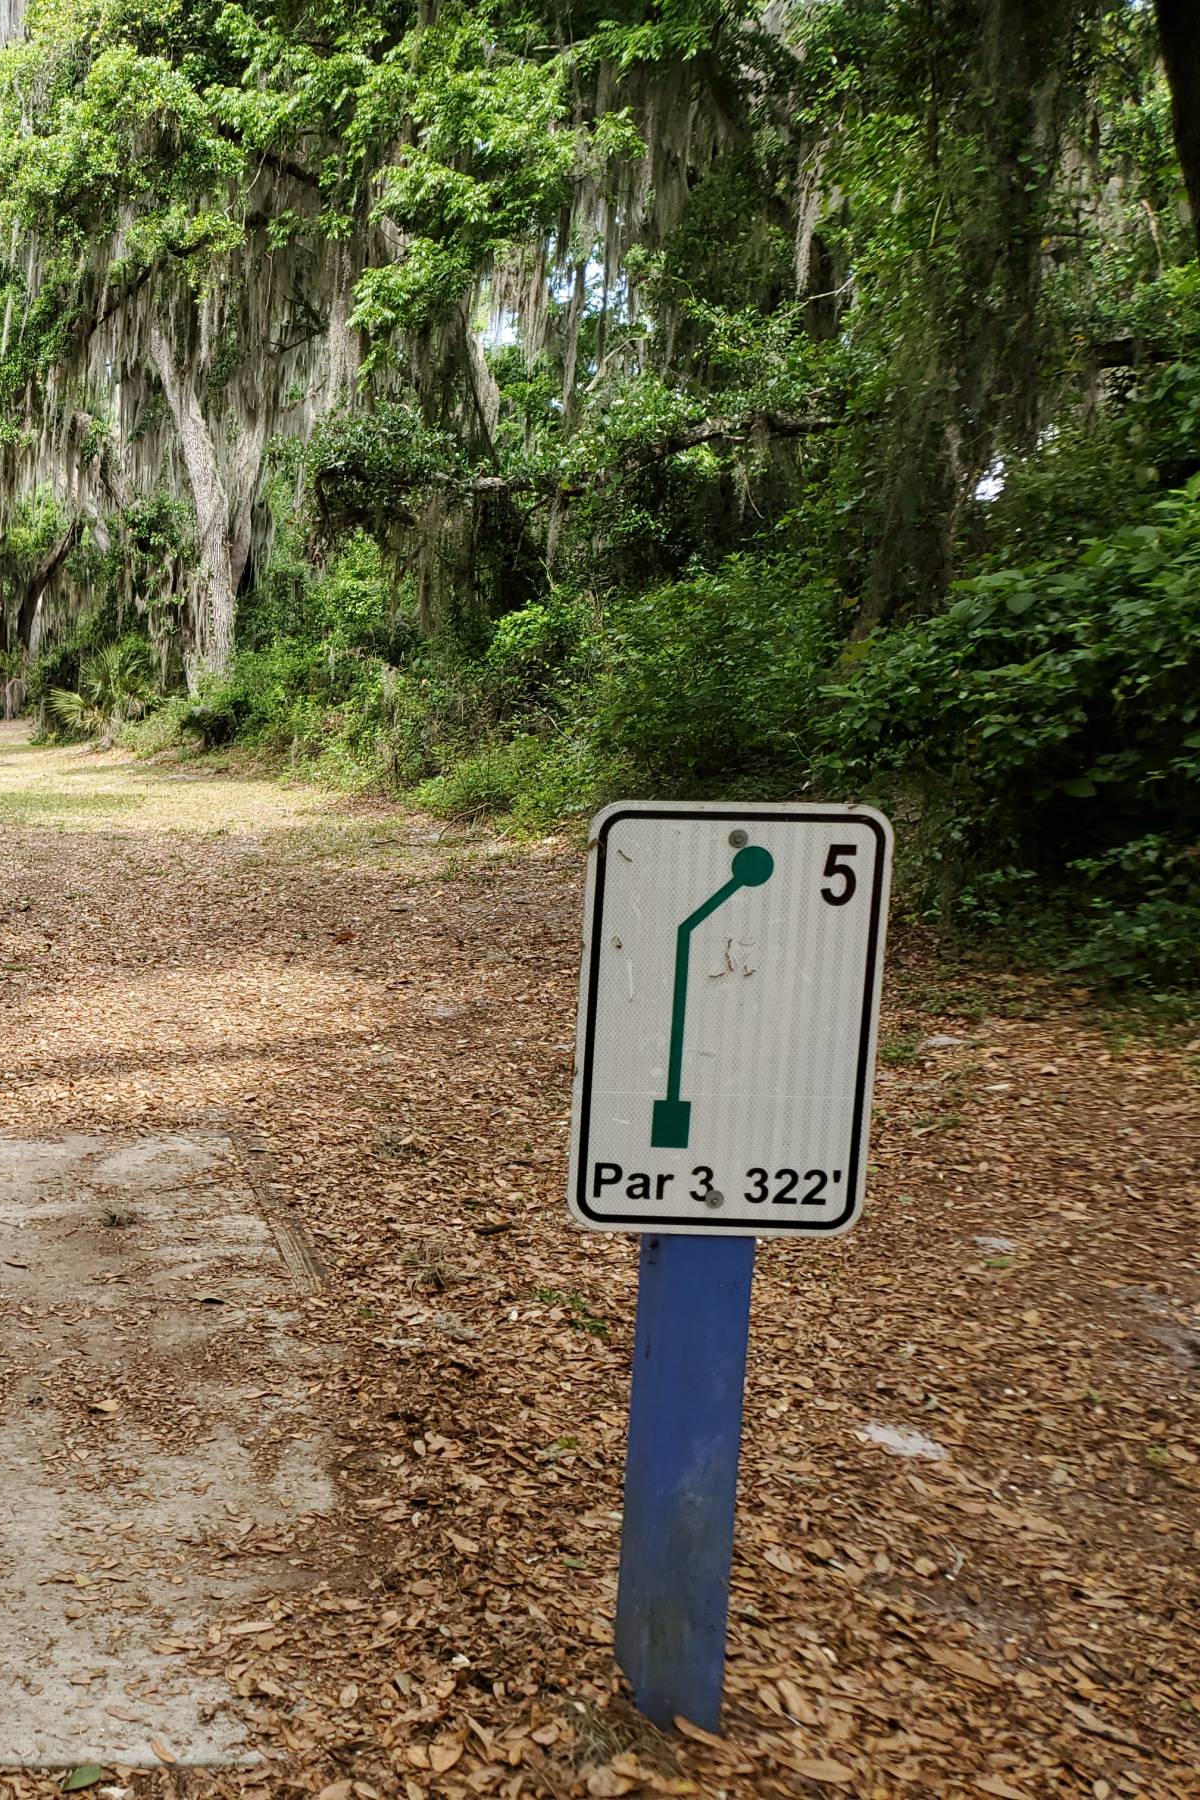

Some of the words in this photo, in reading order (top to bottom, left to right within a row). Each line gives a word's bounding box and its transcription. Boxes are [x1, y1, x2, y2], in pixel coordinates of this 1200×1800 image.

[821, 844, 857, 906] 5
[593, 1162, 675, 1200] Par
[689, 1165, 714, 1202] 3
[744, 1168, 842, 1205] 322'
